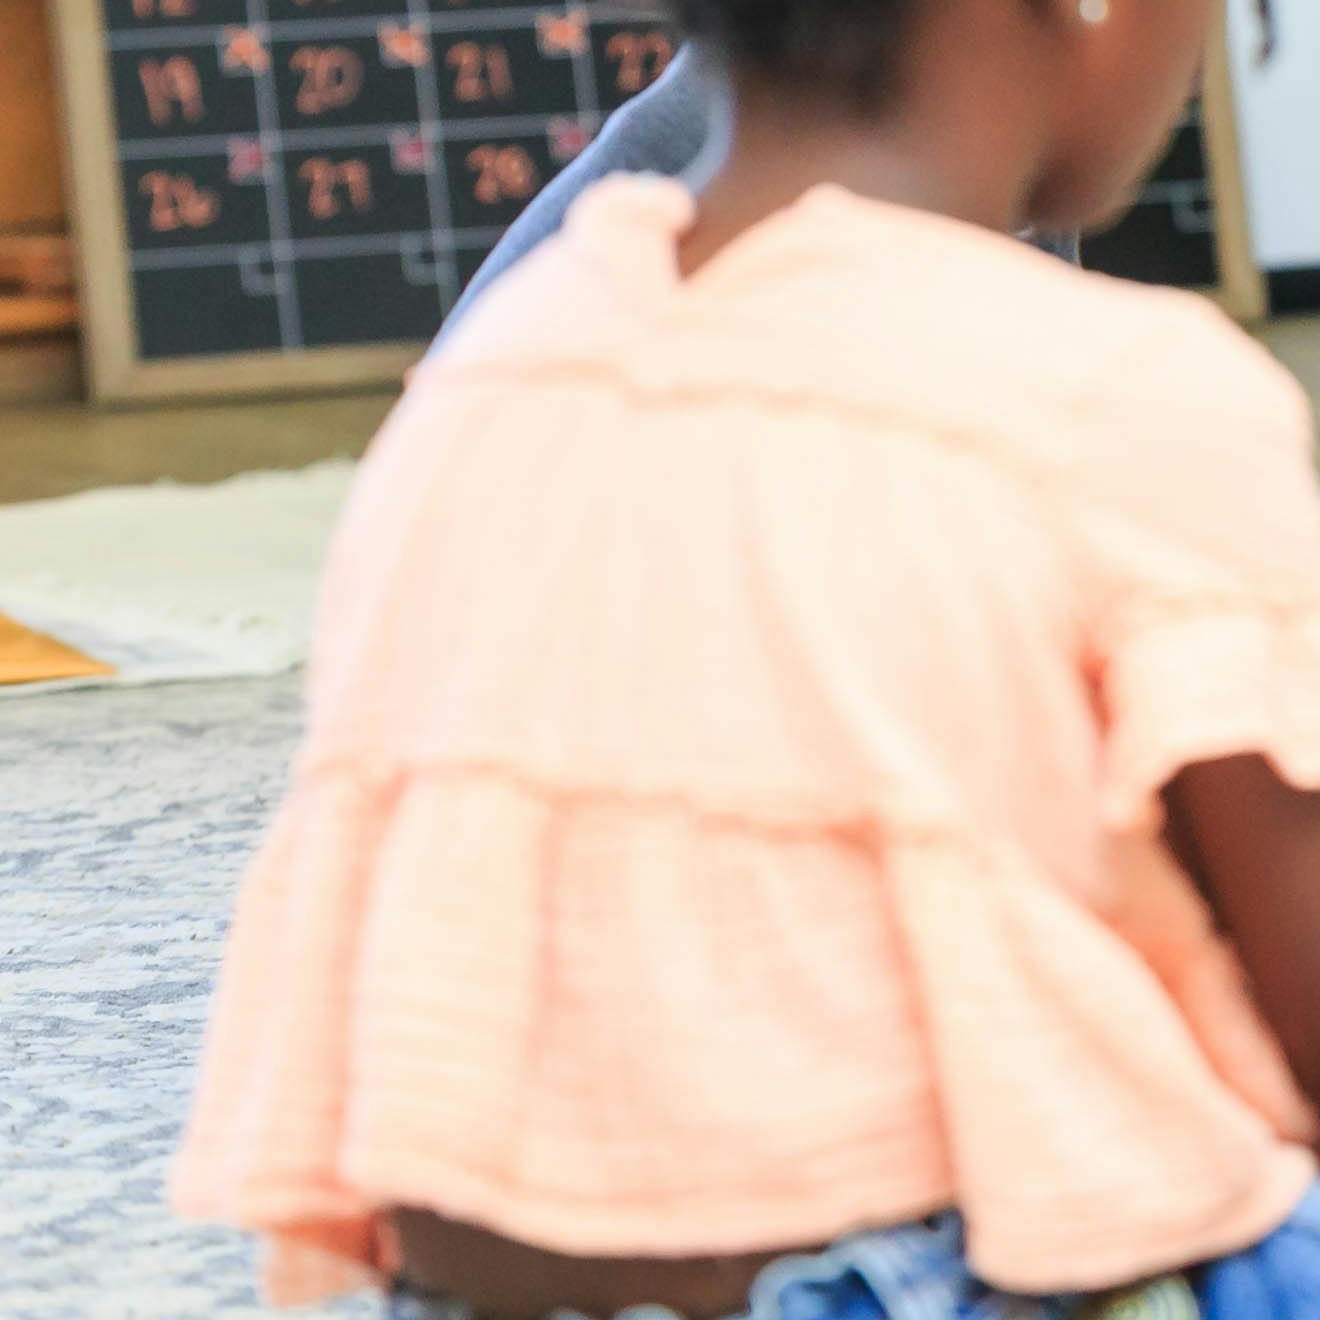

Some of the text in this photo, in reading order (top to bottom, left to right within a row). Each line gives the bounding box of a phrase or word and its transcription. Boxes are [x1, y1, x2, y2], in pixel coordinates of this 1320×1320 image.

[139, 54, 206, 127] 19
[288, 44, 365, 115] 20
[447, 41, 515, 104] 21
[138, 144, 538, 233] 26 27 28
